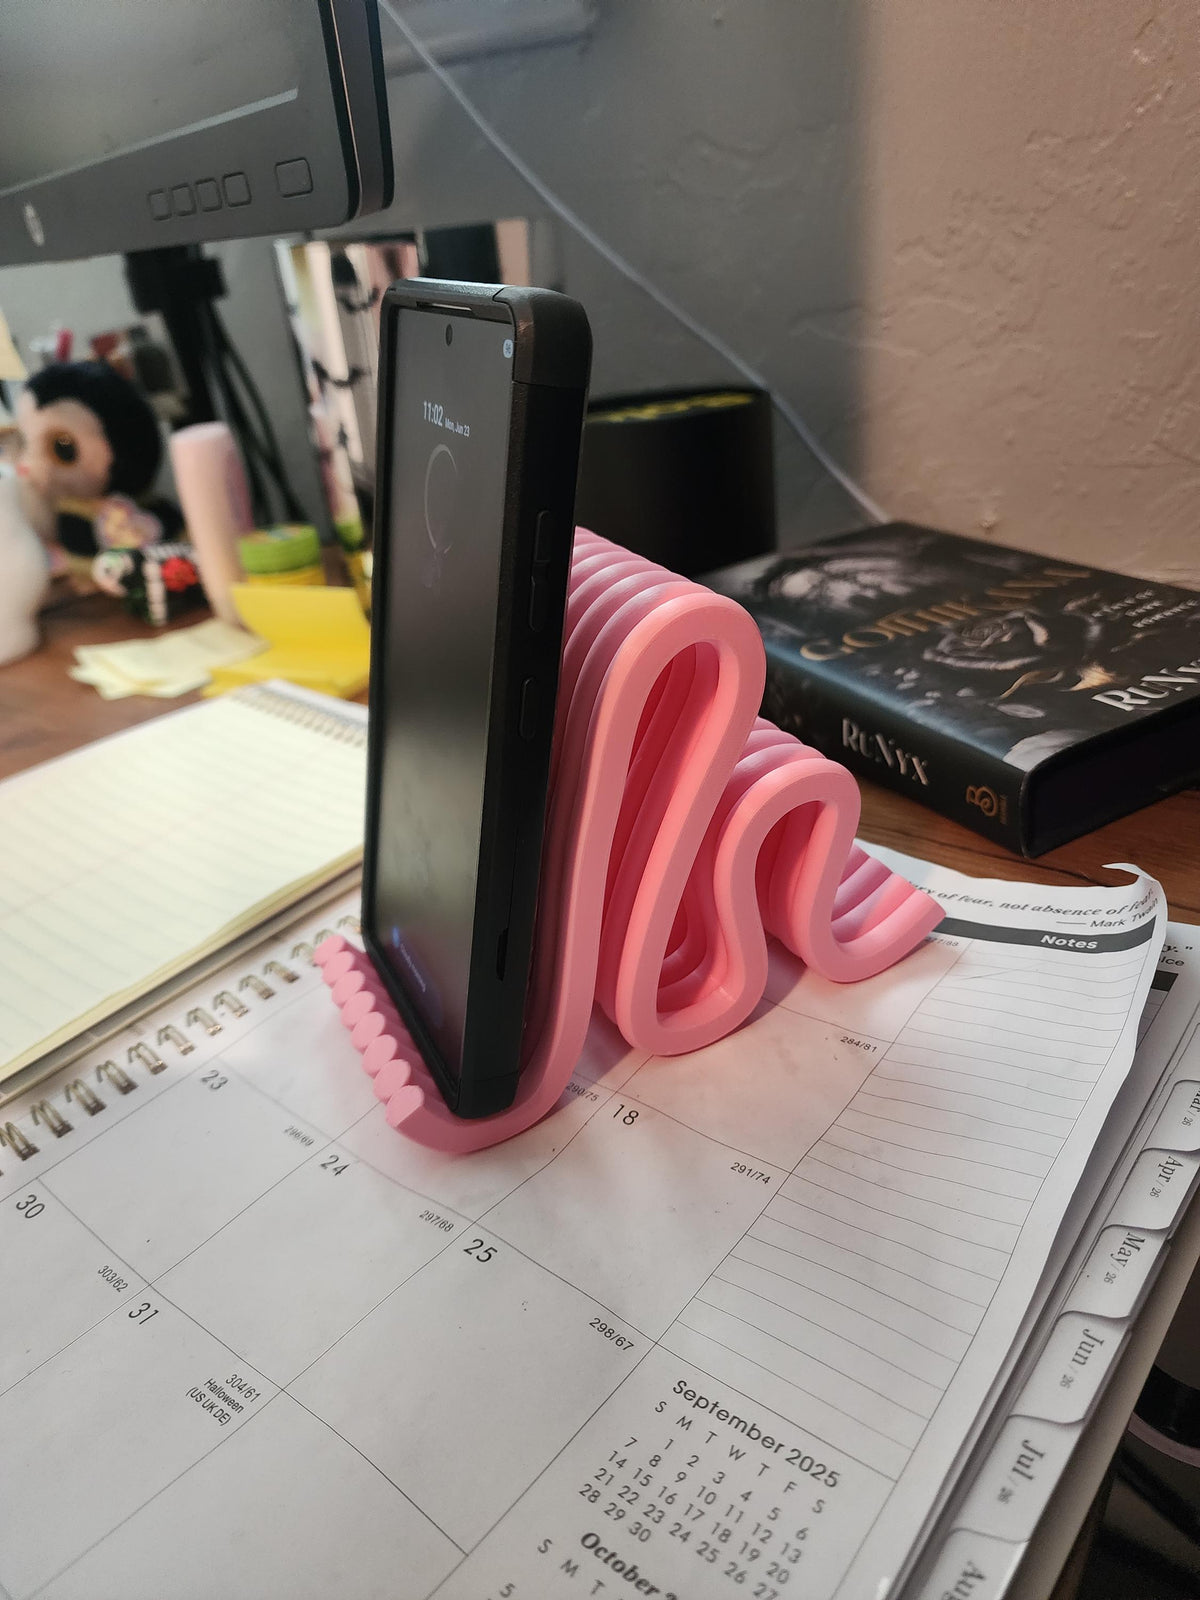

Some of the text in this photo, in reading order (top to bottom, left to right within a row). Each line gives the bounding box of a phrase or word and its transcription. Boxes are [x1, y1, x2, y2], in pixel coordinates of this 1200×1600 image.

[423, 400, 444, 427] 11:02
[842, 717, 929, 786] RUNYX
[937, 890, 958, 899] of
[999, 902, 1029, 911] not
[1030, 904, 1102, 916] absence
[1105, 904, 1129, 915] of
[1090, 918, 1127, 928] Mark
[1040, 934, 1099, 949] Notes
[840, 1035, 878, 1053] 284/81
[200, 1069, 230, 1090] 23
[565, 1081, 599, 1102] 290/75
[612, 1103, 640, 1126] 18
[320, 1154, 350, 1177] 24
[730, 1161, 771, 1185] 291/74
[1158, 1155, 1184, 1183] Apr
[15, 1194, 46, 1219] 30
[463, 1238, 498, 1263] 25
[1110, 1232, 1145, 1268] May
[97, 1265, 129, 1293] 303/62
[1103, 1271, 1117, 1285] 26
[128, 1302, 160, 1325] 31
[589, 1317, 635, 1353] 298/67
[1072, 1328, 1105, 1366] Jun
[204, 1378, 245, 1414] Halloween
[225, 1373, 261, 1403] 304/61
[185, 1387, 232, 1427] (US UK DE)
[672, 1380, 841, 1488] September 2025
[655, 1401, 826, 1514] S M T W T F S
[1012, 1439, 1045, 1481] Jul
[624, 1436, 802, 1564] 7 8 9 10 11 12 13
[664, 1438, 809, 1541] 1 2 3 4 5 6
[579, 1483, 651, 1543] 28 29 30
[607, 1450, 790, 1585] 14 15 16 17 18 19 20
[594, 1467, 779, 1600] 21 22 23 24 25 26 27
[537, 1538, 606, 1596] S M T
[580, 1532, 661, 1597] October
